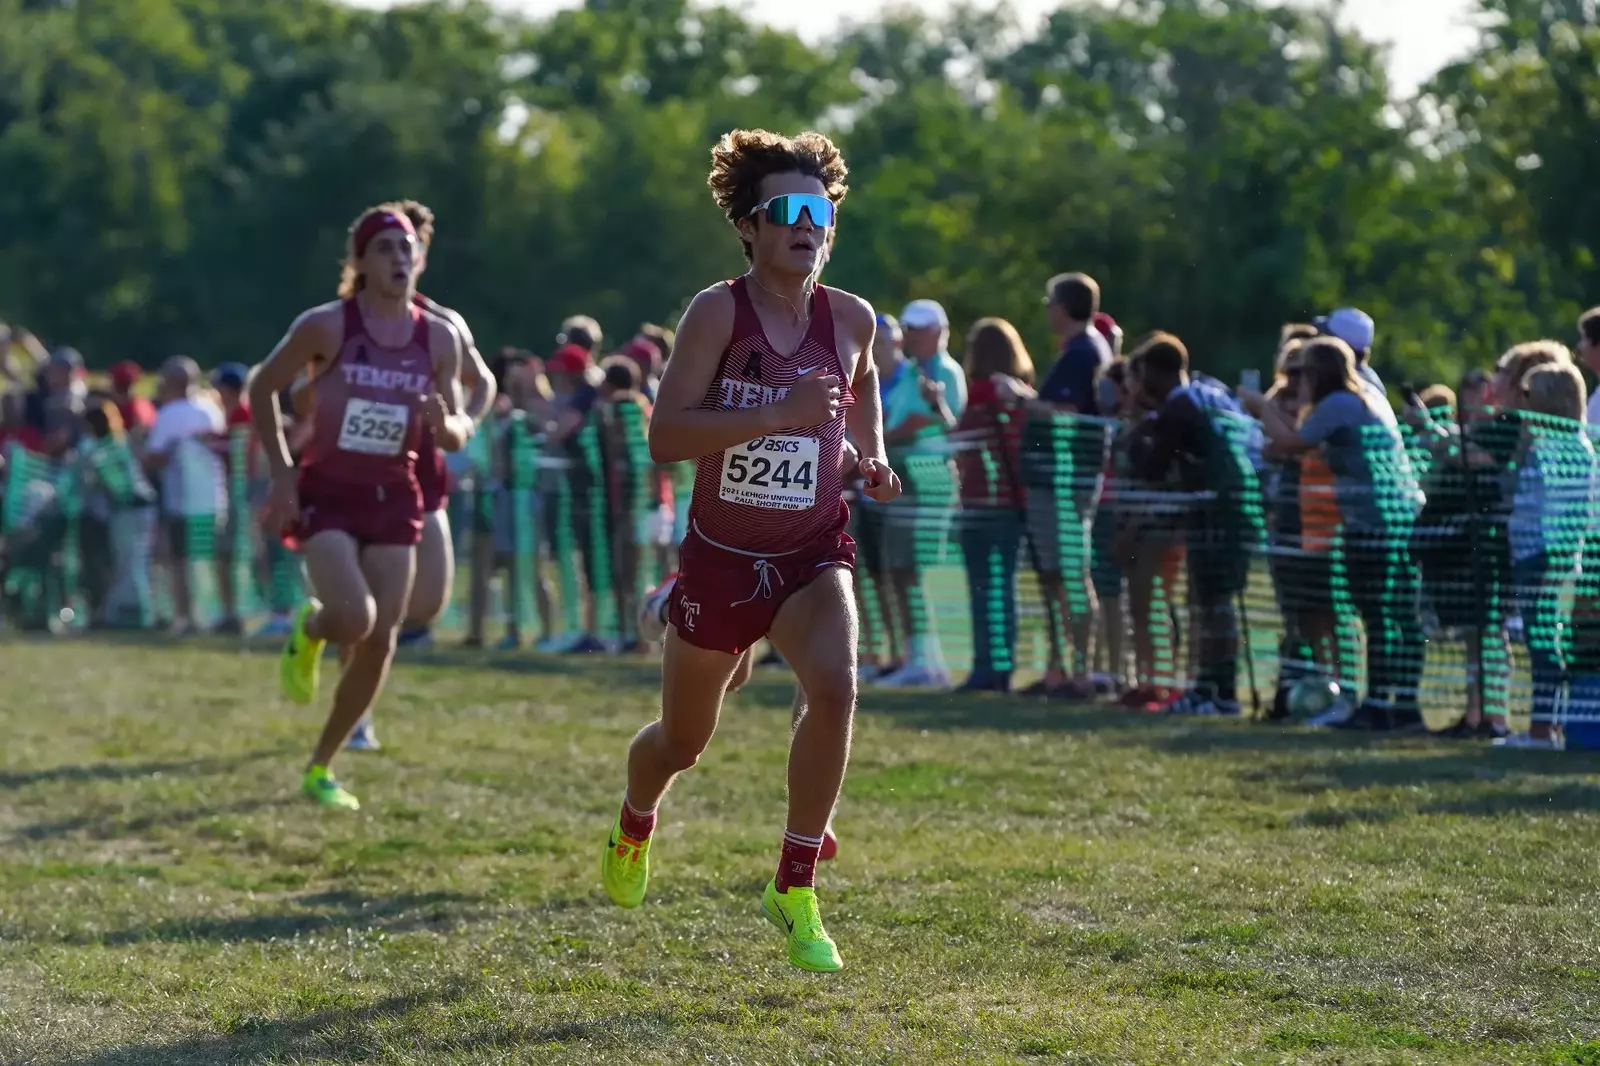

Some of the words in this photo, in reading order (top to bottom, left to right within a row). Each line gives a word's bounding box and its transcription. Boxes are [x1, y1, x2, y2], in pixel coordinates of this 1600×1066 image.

[720, 377, 791, 409] TEM
[346, 415, 404, 441] 5252
[726, 453, 813, 490] 5244
[721, 486, 739, 495] 2021
[741, 490, 770, 500] LEHIGH
[770, 494, 814, 504] UNIVERSITY
[734, 496, 754, 505] PAUL
[755, 500, 781, 509] SHORT
